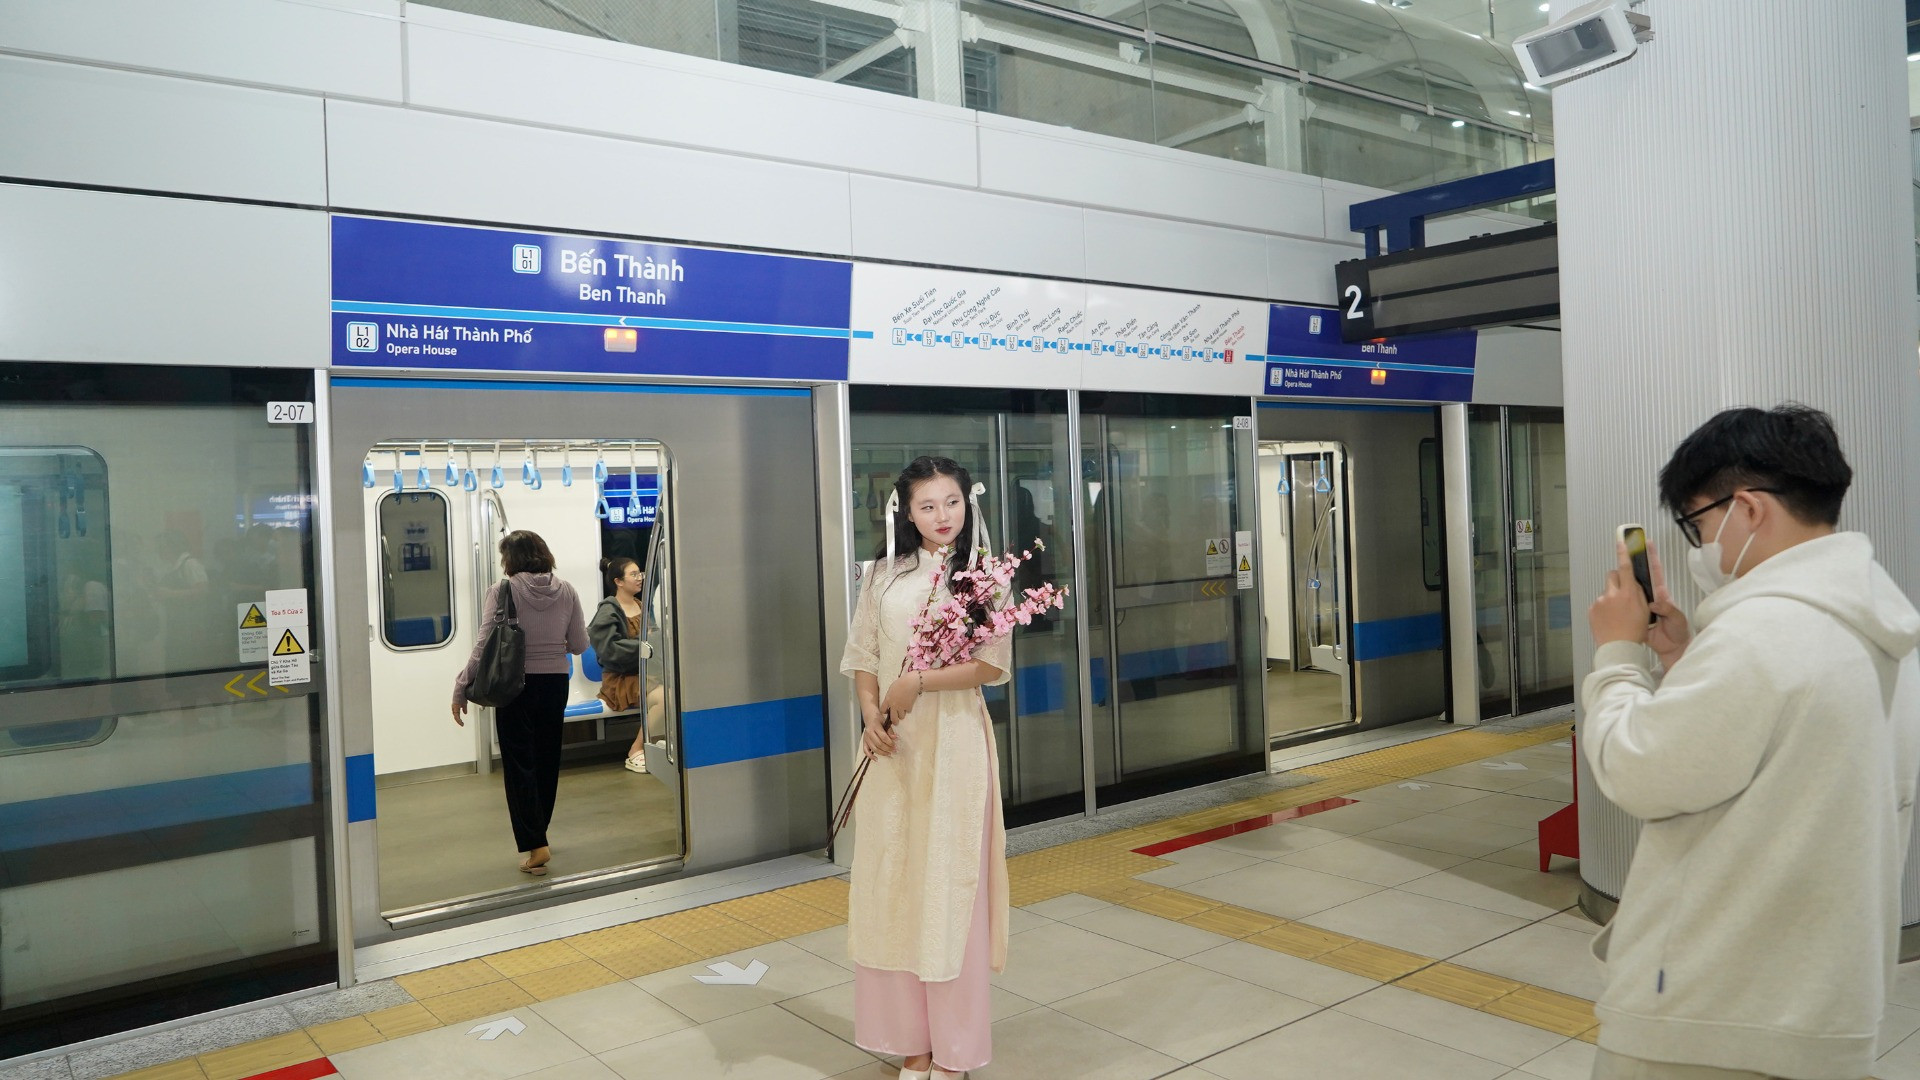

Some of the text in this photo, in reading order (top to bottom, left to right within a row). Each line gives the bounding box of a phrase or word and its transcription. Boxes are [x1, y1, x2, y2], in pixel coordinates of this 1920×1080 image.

[522, 249, 532, 259] L1
[522, 260, 532, 269] 01
[561, 249, 684, 282] Bến Thành
[580, 284, 666, 305] Ben Thanh
[951, 316, 964, 327] Khu
[990, 286, 1001, 297] Cao
[1344, 285, 1364, 320] 2
[904, 305, 912, 313] Xe
[356, 326, 369, 336] L1
[386, 323, 534, 343] Nhà Hát Thành Phố
[356, 338, 369, 347] 02
[386, 343, 457, 356] Opera House
[1362, 343, 1398, 355] Ben Thanh
[1285, 368, 1342, 380] Nhà Hát Thành Phố
[1284, 380, 1298, 388] Opera
[274, 405, 305, 420] 2-07
[1237, 418, 1248, 428] 2-08
